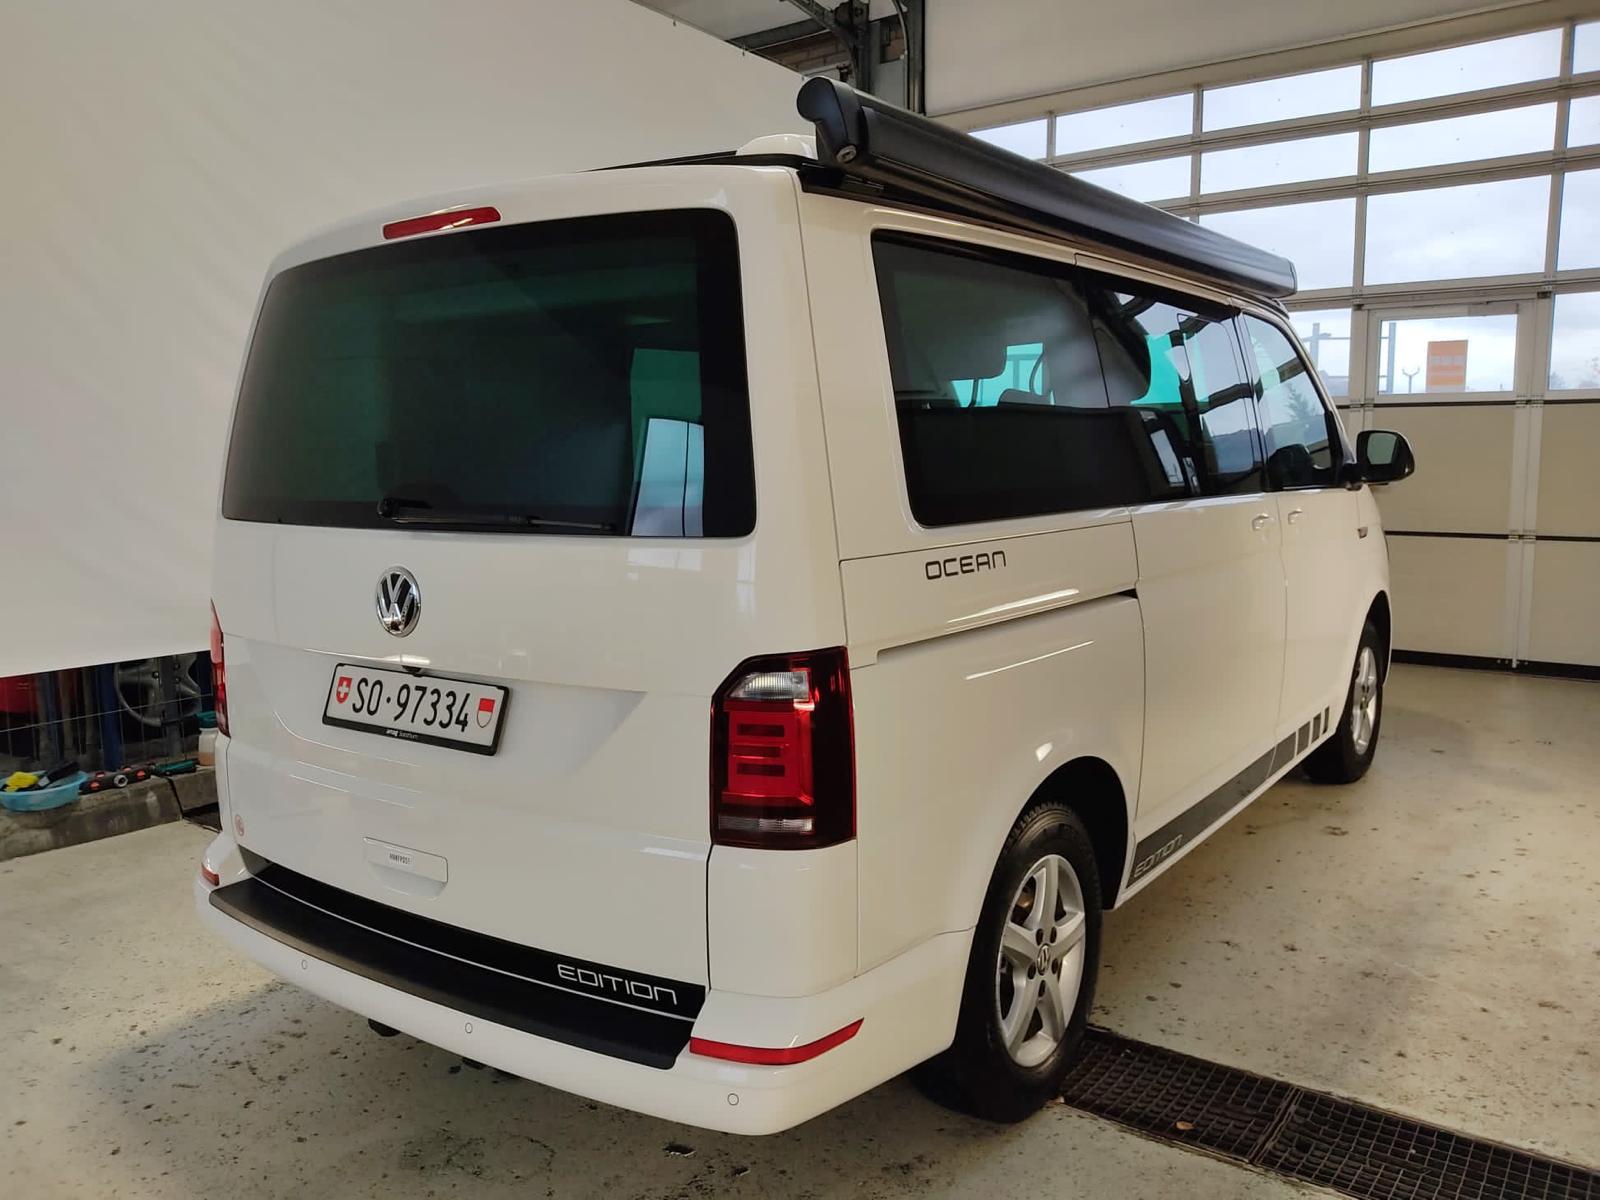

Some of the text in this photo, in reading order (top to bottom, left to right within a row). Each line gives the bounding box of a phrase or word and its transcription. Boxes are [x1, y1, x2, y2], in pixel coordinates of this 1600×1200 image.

[925, 550, 1007, 580] OCEAN
[376, 565, 422, 638] VW
[557, 963, 678, 1006] EDITION
